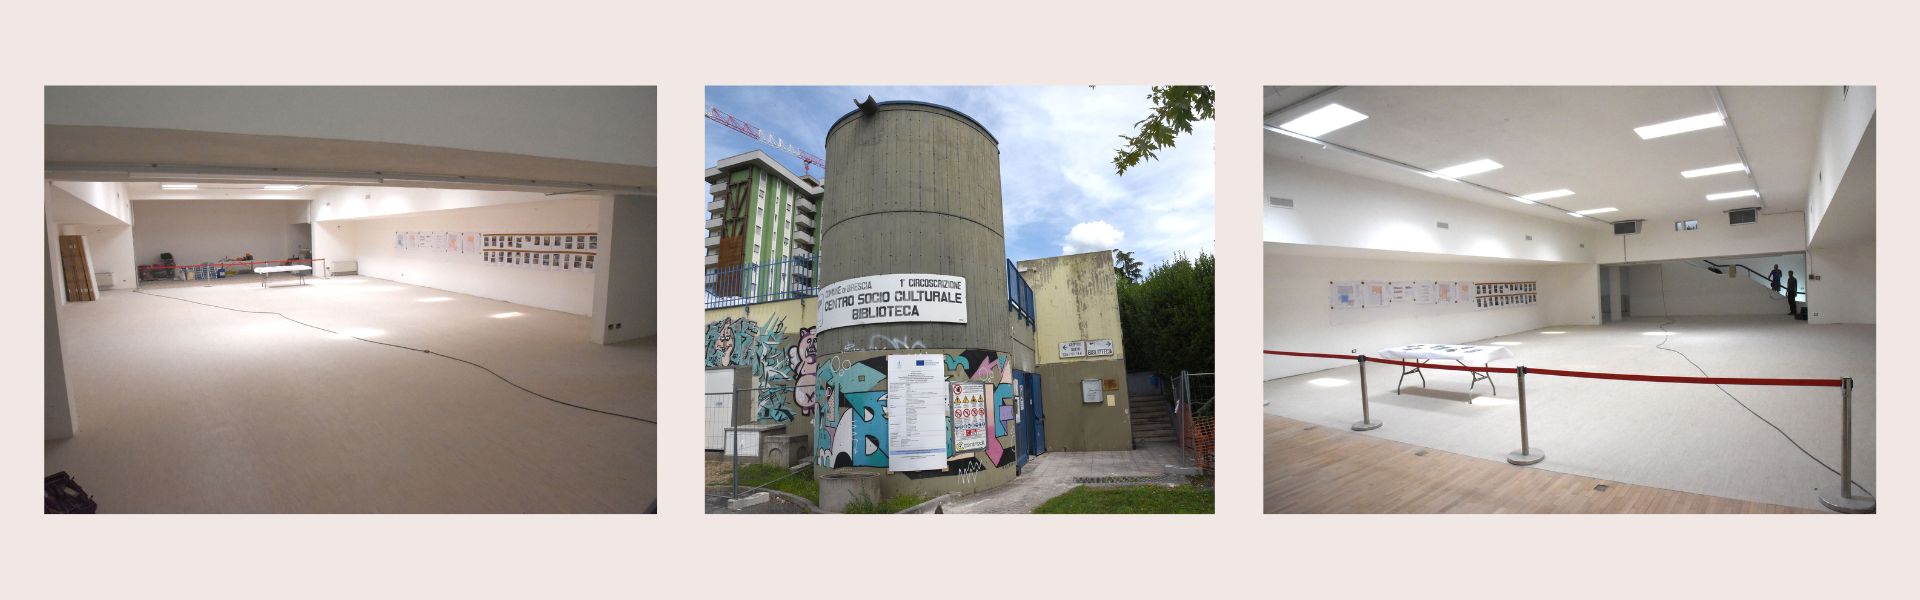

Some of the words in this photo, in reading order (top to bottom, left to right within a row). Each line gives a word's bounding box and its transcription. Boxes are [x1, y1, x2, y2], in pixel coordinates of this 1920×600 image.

[847, 281, 872, 293] BRESCIA
[908, 278, 962, 290] CIRCOSCRIZIONE
[824, 295, 855, 312] CENTRO
[858, 291, 890, 305] SOCIO
[894, 290, 963, 304] CULTURALE
[852, 305, 920, 320] BIBLIOTECA
